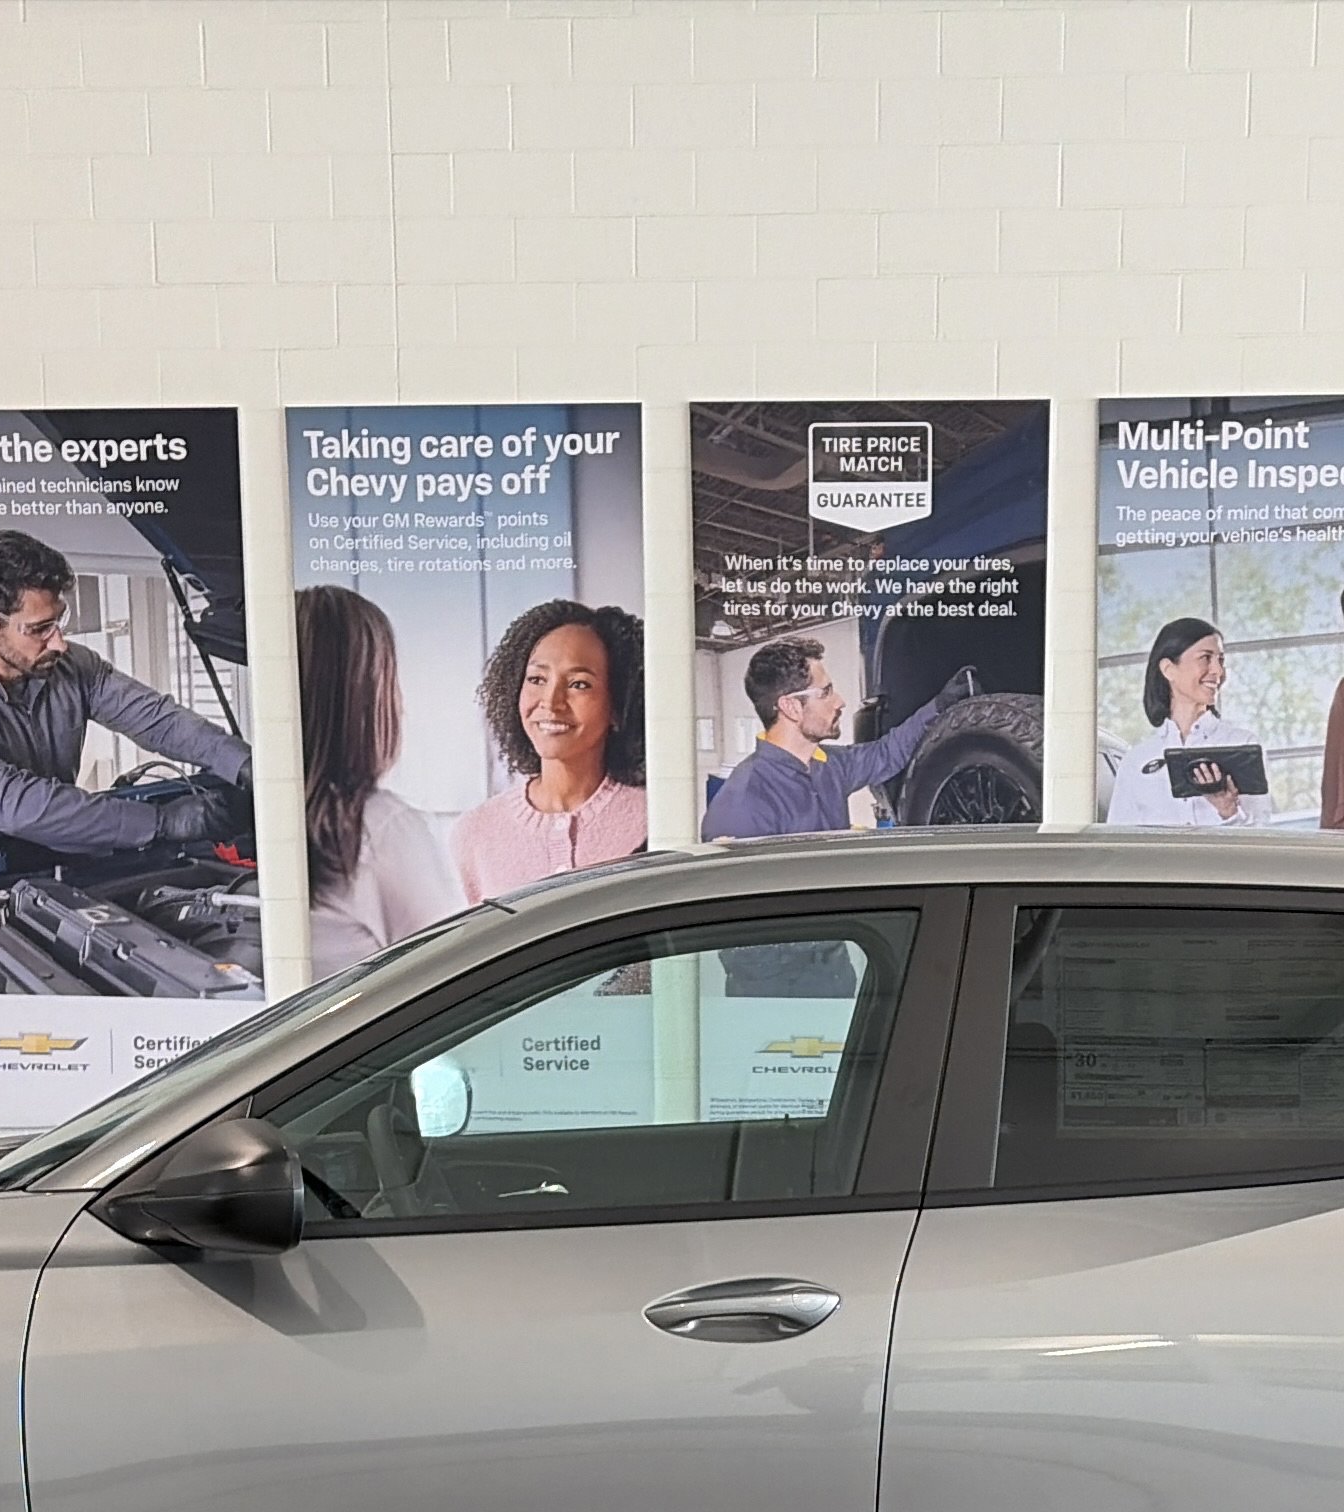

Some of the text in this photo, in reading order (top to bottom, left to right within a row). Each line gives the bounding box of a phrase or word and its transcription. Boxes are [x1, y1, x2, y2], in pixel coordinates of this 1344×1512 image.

[1118, 419, 1310, 450] Multi-Point
[61, 433, 188, 468] experts
[303, 427, 620, 465] Taking care of your
[822, 437, 921, 452] TIRE PRICE
[840, 457, 903, 472] MATCH
[1117, 458, 1238, 489] Vehicle
[40, 477, 132, 493] technicians
[136, 476, 180, 491] know
[307, 464, 551, 502] Chevy pays off
[11, 499, 62, 514] better
[66, 499, 102, 514] than
[106, 500, 168, 517] anyone.
[817, 493, 926, 508] GUARANTEE
[309, 513, 339, 528] Use
[343, 516, 378, 530] your
[383, 513, 409, 528] GM
[498, 512, 548, 527] points
[1116, 506, 1146, 521] The
[1151, 508, 1202, 524] peace
[1206, 506, 1223, 521] of
[1228, 506, 1269, 520] mind
[1274, 504, 1308, 520] that
[310, 532, 572, 551] on Certified Service, including oil
[1116, 528, 1176, 546] getting
[1180, 531, 1216, 546] your
[310, 556, 577, 574] changes, tire rotations and more.
[725, 555, 773, 571] When
[806, 555, 843, 570] time
[848, 555, 865, 571] to
[869, 555, 929, 574] replace
[933, 558, 969, 573] your
[973, 555, 1015, 573] tires,
[721, 578, 1019, 596] let us do the work. We have the right
[724, 601, 1017, 619] tires for your Chevy at the best deal.
[522, 1035, 601, 1053] Certified
[523, 1056, 590, 1071] Service
[1074, 1053, 1096, 1068] 30
